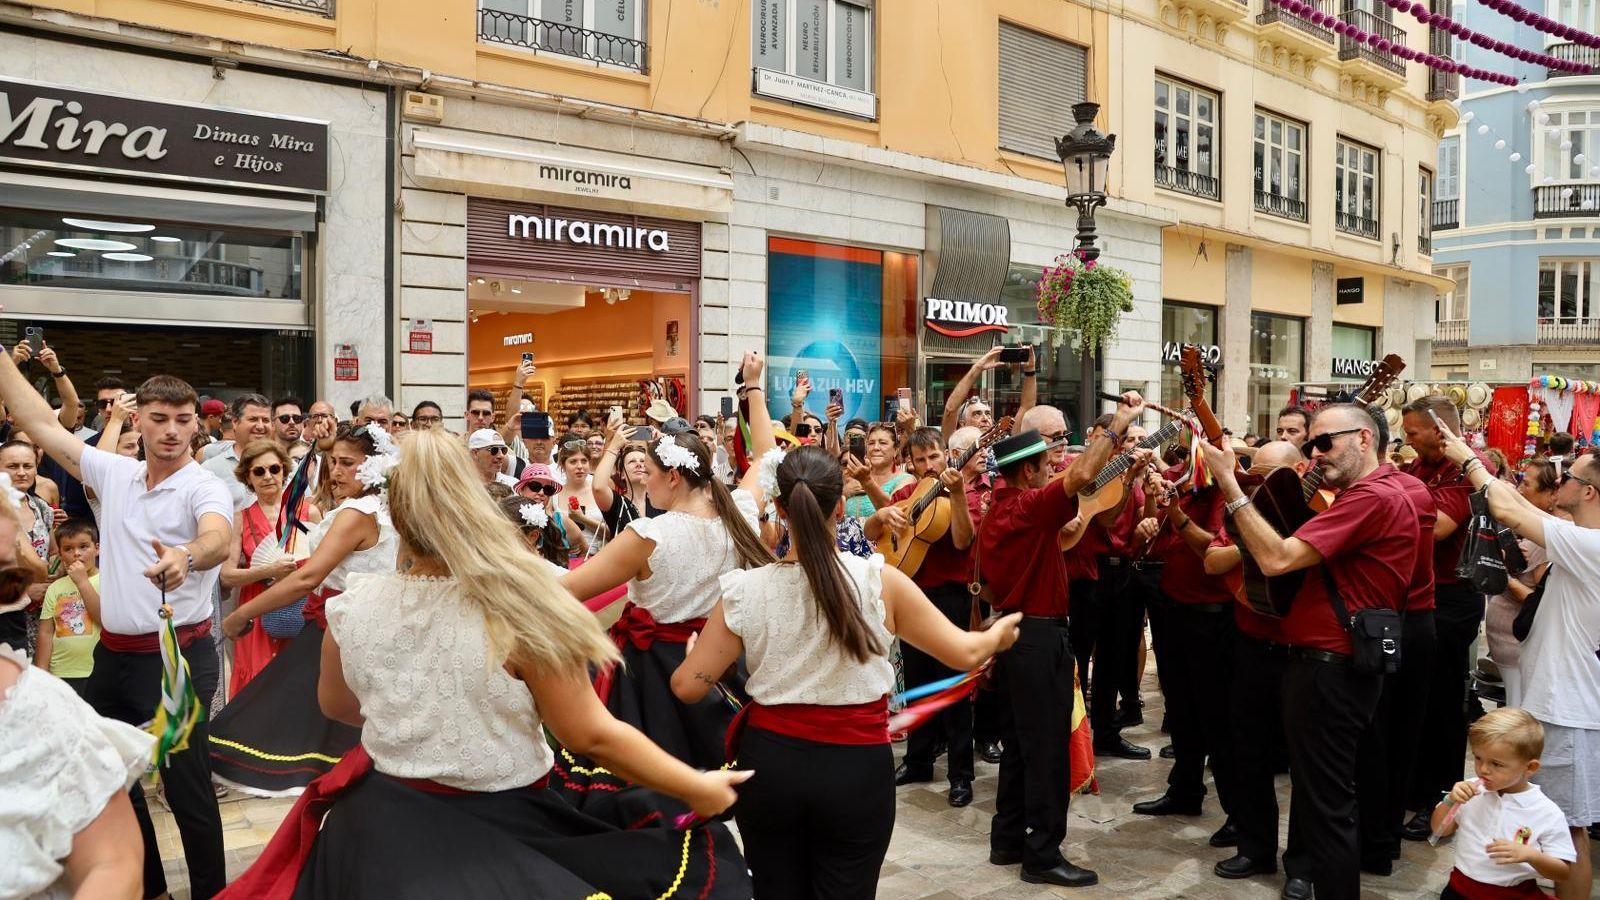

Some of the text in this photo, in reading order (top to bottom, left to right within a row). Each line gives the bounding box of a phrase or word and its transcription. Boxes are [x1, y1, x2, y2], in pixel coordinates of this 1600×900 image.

[0, 91, 168, 160] Mira
[193, 123, 314, 152] Dimas Mira
[214, 153, 284, 173] e Hijos
[540, 165, 631, 190] miramira
[508, 213, 670, 252] miramira
[925, 298, 1008, 326] PRIMOR
[504, 332, 533, 347] miramira
[774, 375, 798, 391] LU
[846, 379, 874, 394] HEV
